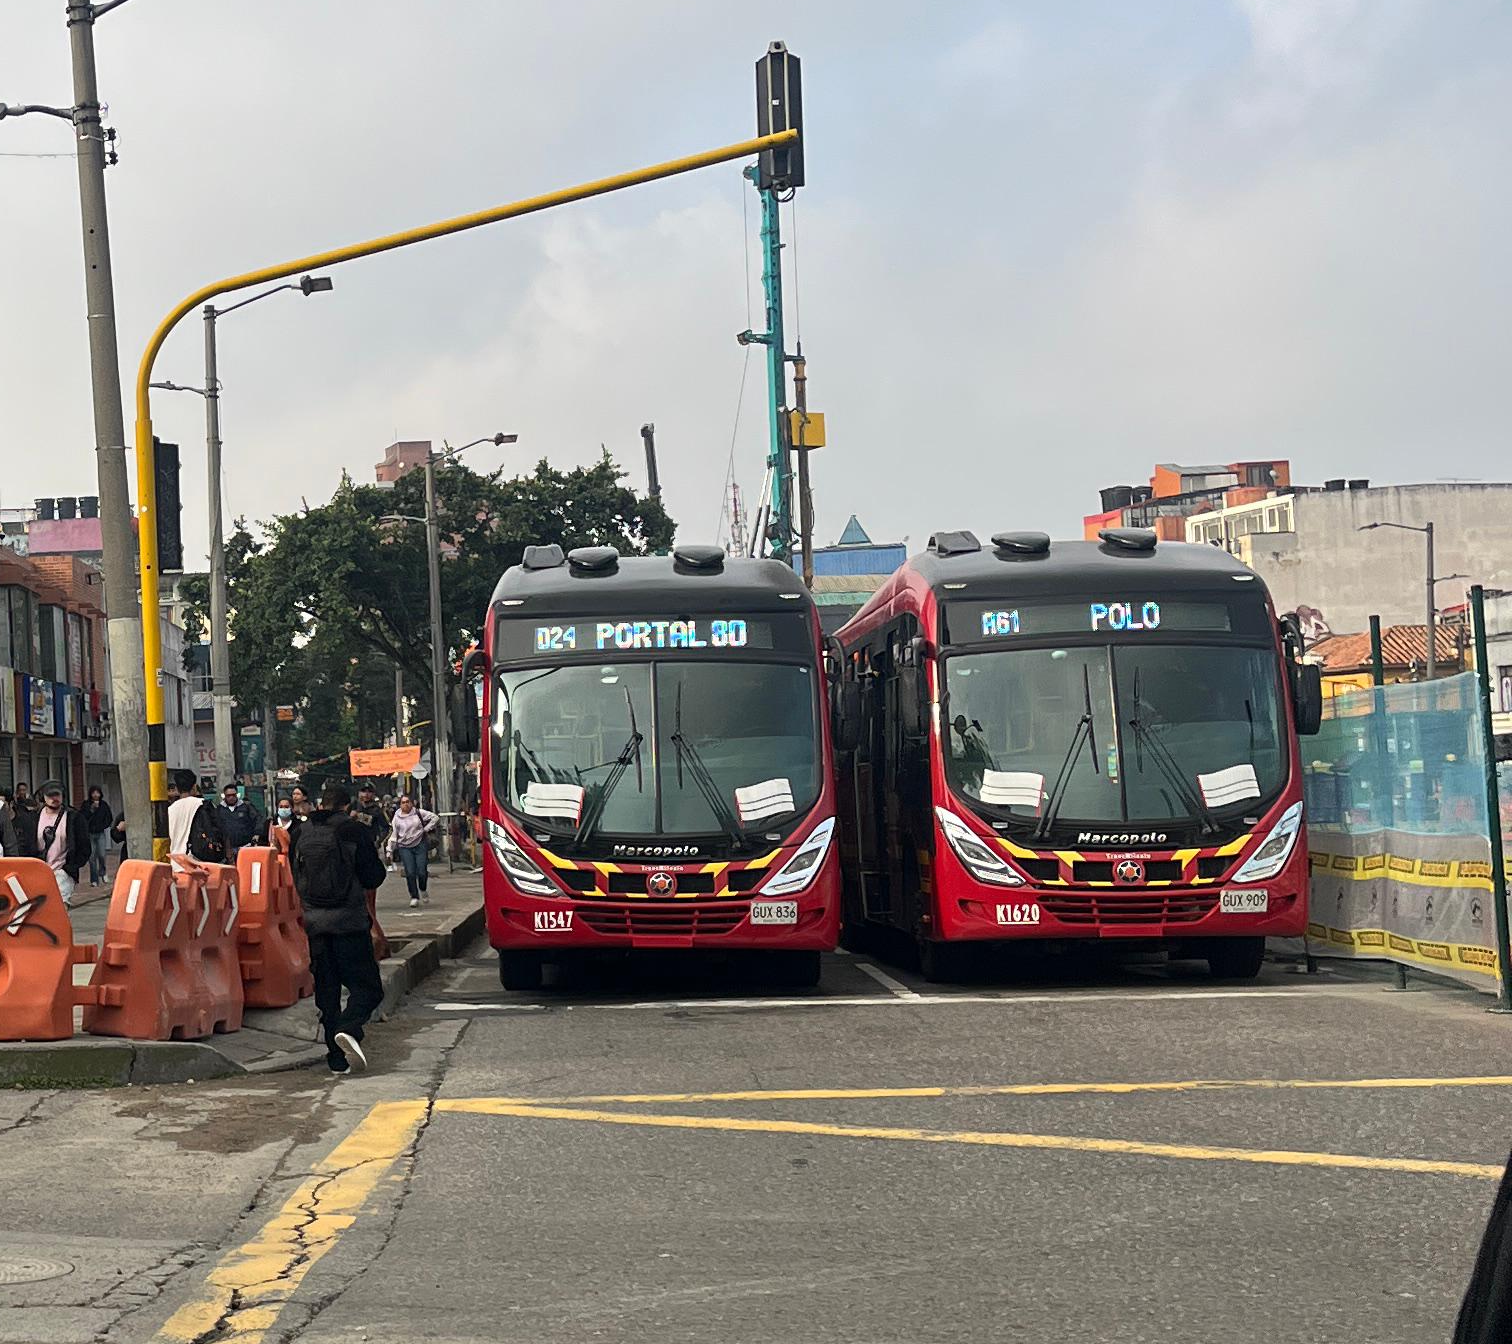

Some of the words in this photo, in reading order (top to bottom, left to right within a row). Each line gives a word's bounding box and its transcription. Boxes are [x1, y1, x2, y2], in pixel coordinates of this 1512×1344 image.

[1090, 602, 1160, 631] POLO
[537, 626, 576, 650] D24
[596, 621, 707, 649] PORTAL
[711, 620, 747, 647] 80
[1078, 832, 1167, 844] Marcopolo
[613, 844, 699, 856] Marcopolo
[1223, 894, 1244, 907] GUX
[1246, 893, 1266, 906] 909
[534, 911, 573, 929] K1547
[752, 905, 773, 919] GUX
[776, 905, 796, 918] 836
[996, 904, 1039, 922] K1620
